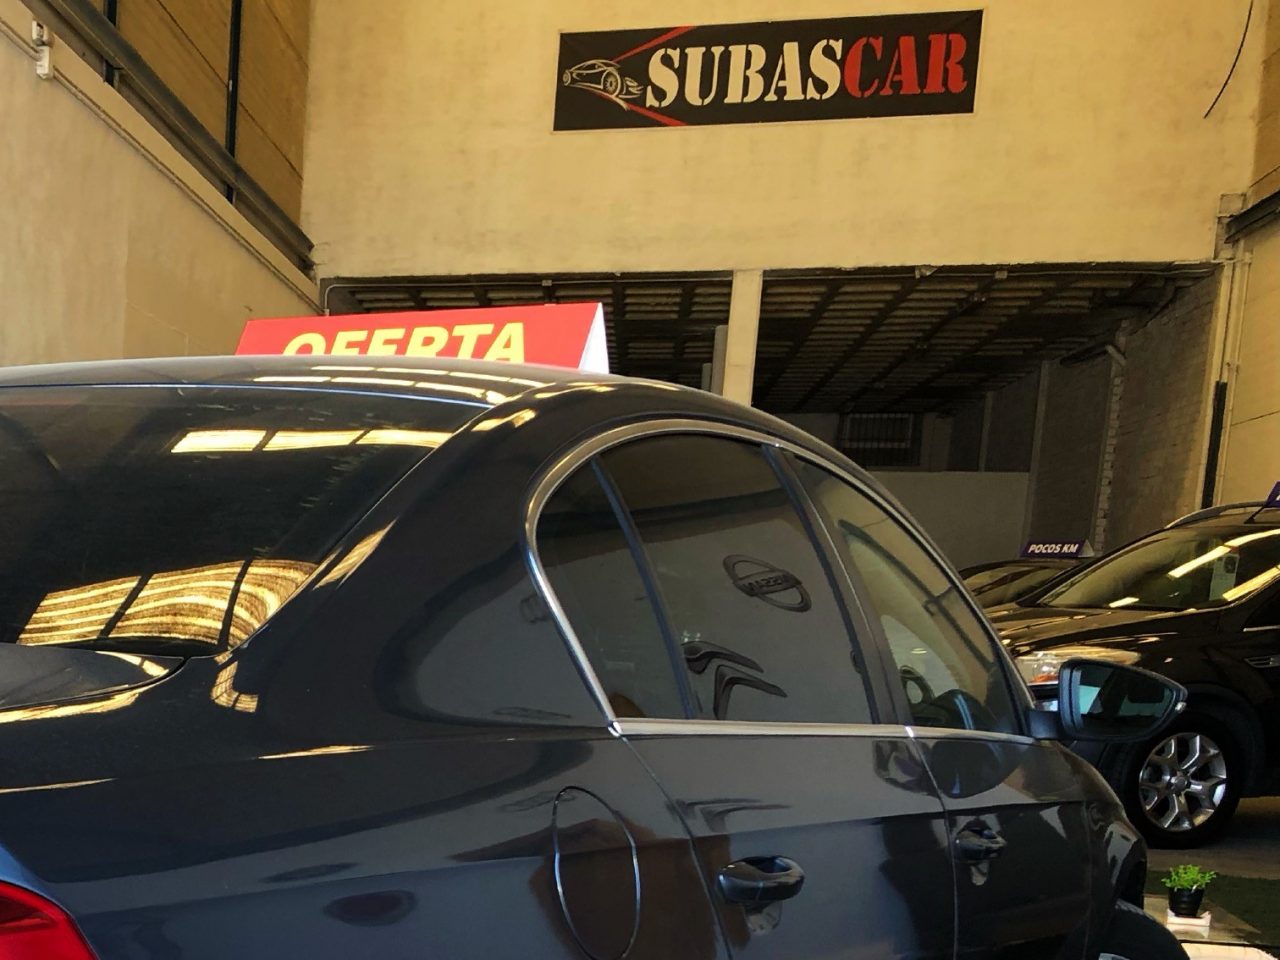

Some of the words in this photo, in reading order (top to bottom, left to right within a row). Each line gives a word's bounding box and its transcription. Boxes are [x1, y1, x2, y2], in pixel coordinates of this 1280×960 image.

[645, 33, 968, 108] SUBASCAR
[1028, 543, 1062, 554] POCOS
[1061, 543, 1079, 554] KM
